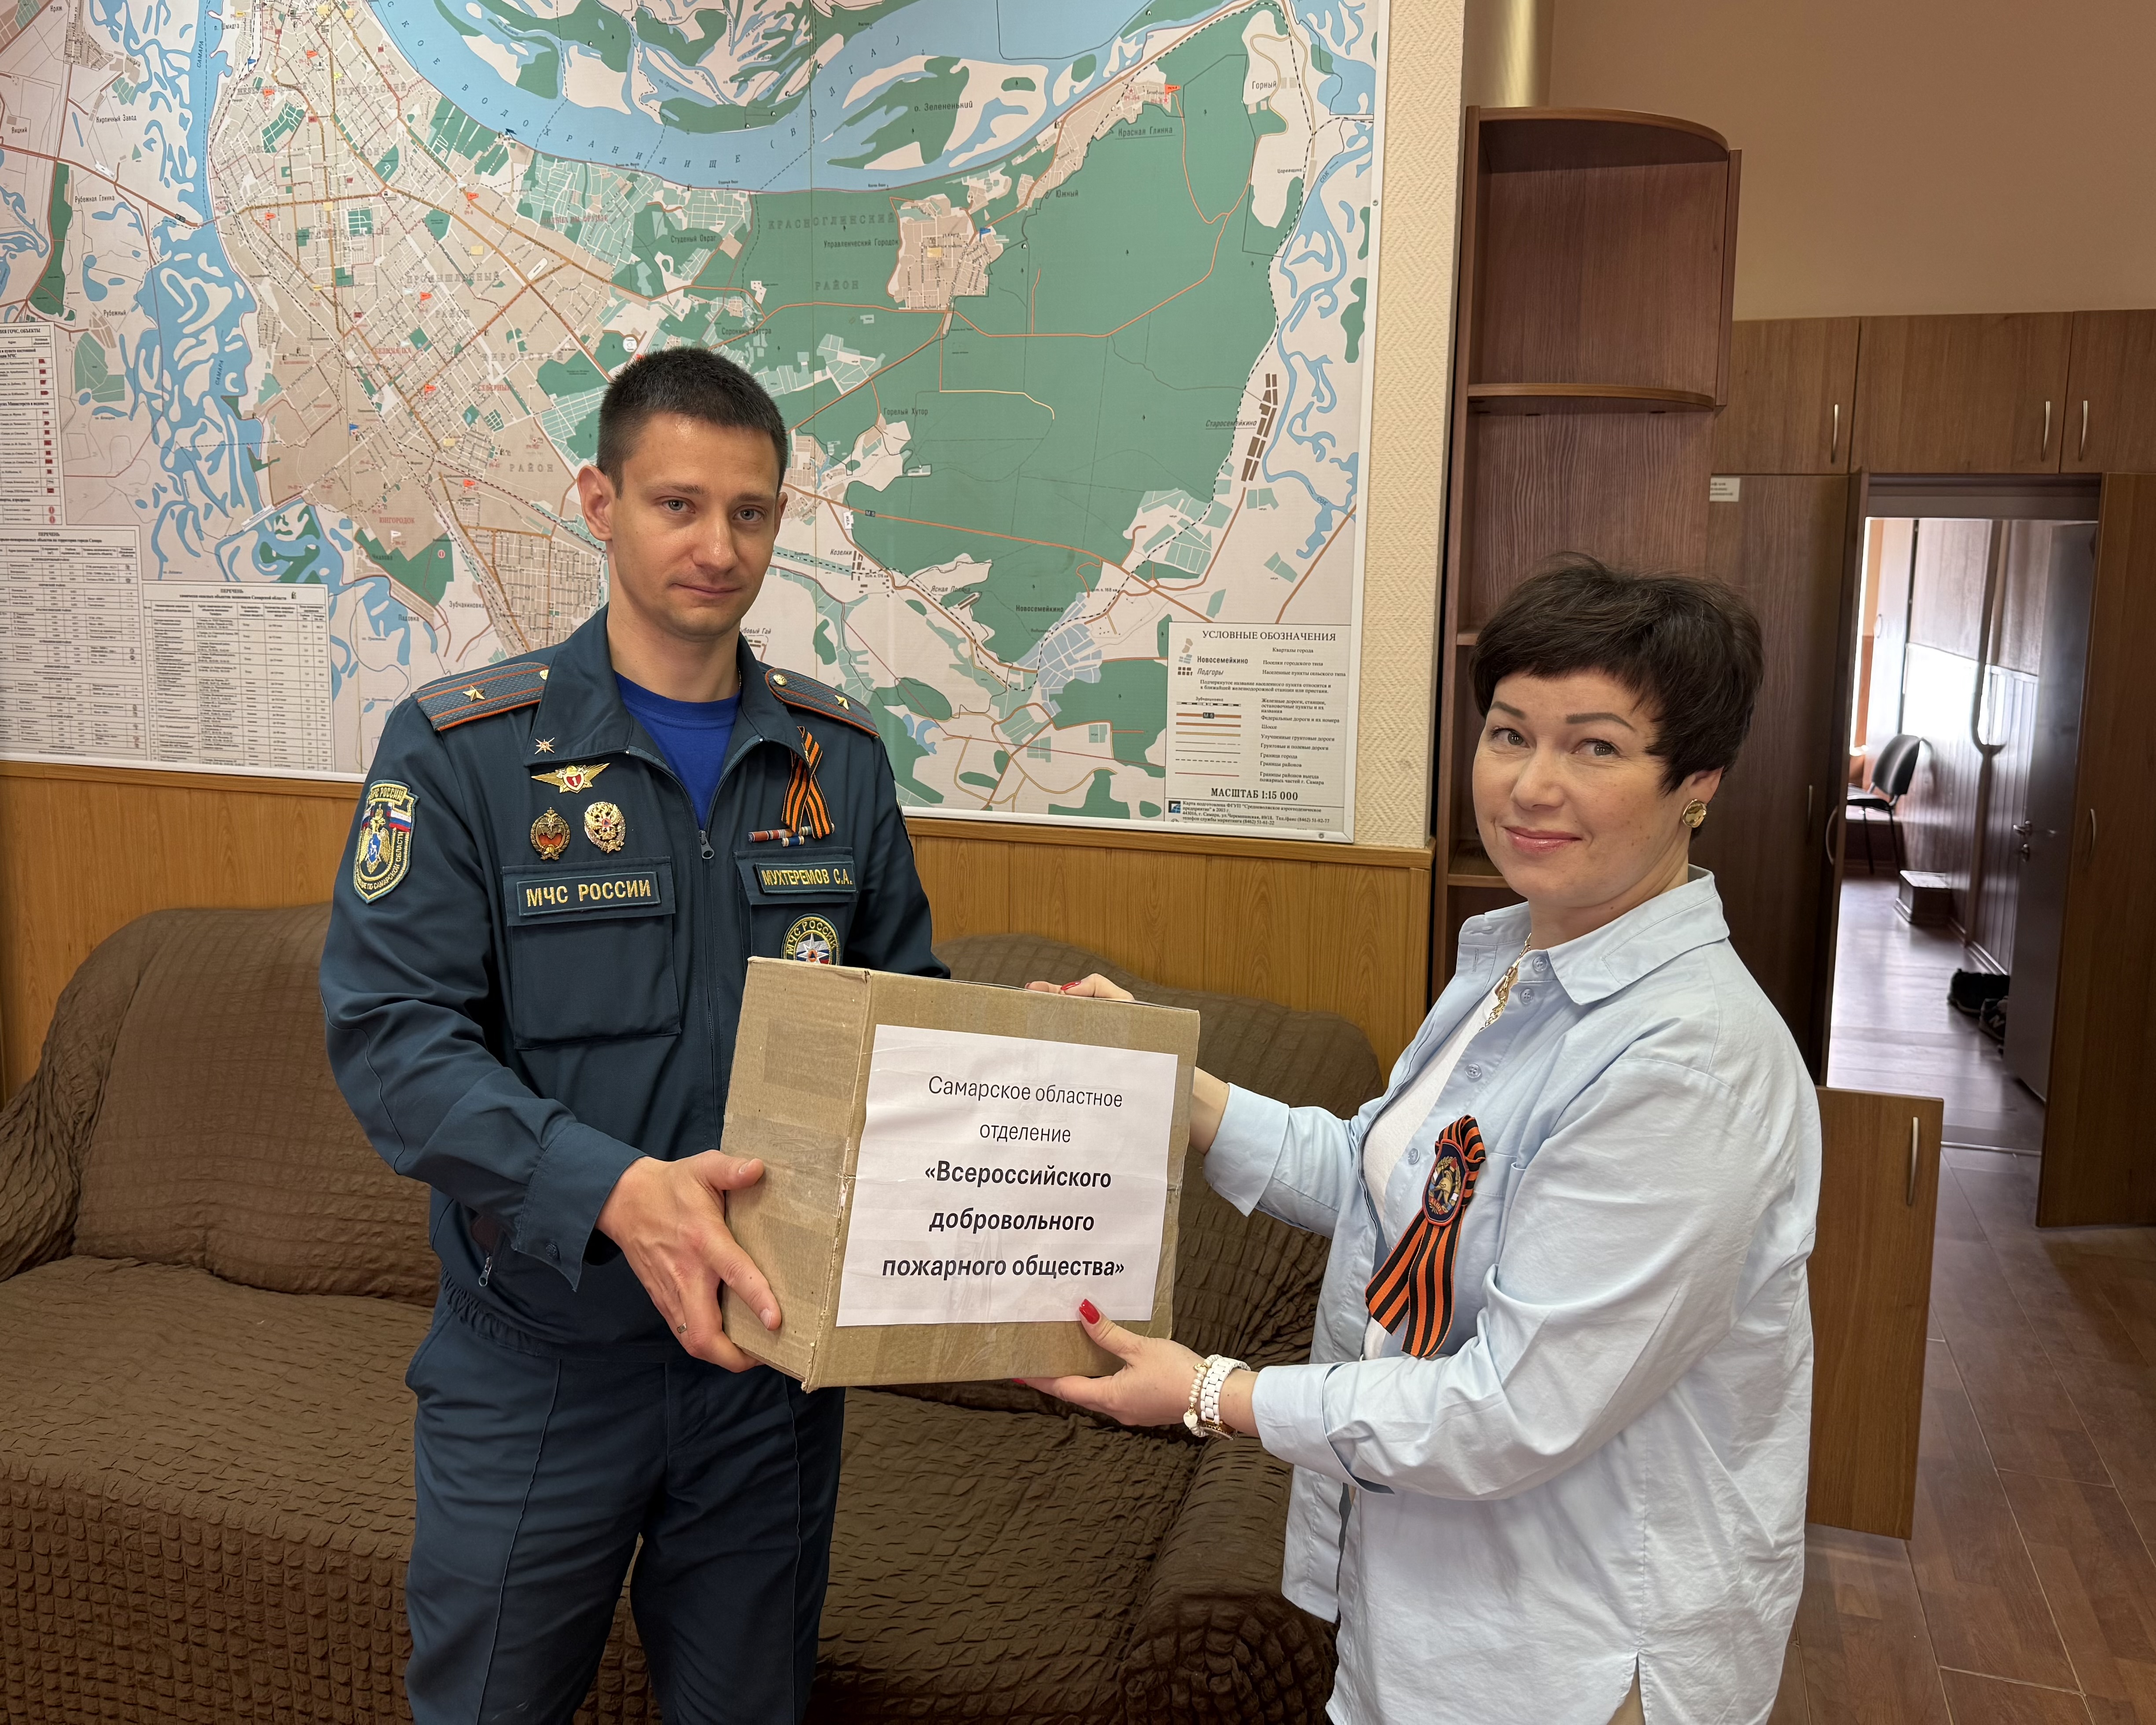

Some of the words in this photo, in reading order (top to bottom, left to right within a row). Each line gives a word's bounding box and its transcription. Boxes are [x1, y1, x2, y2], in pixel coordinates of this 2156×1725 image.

[1252, 81, 1277, 90] Горный
[924, 101, 973, 111] Зелененький
[1118, 128, 1146, 137] Красная
[1150, 126, 1172, 134] Глинка
[1319, 170, 1330, 183] СОК
[768, 212, 895, 230] КРАСНОГЛИНСКИЙ
[671, 235, 697, 243] Студеный
[823, 239, 871, 249] Управленческий
[874, 238, 899, 247] Городок
[815, 280, 859, 291] РАЙОН
[215, 360, 224, 385] САМАРА
[509, 462, 554, 472] РАЙОН
[1317, 496, 1328, 506] СОК
[1016, 604, 1064, 613] Новосемейкино
[1202, 631, 1258, 640] УСЛОВНЫЕ
[1260, 632, 1336, 641] ОБОЗНАЧЕНИЯ
[572, 776, 578, 786] 1
[380, 787, 404, 801] РОССИИ
[1211, 788, 1259, 799] МАСШТАБ
[1262, 791, 1277, 800] 1:15
[1280, 791, 1298, 801] 000
[396, 831, 404, 863] ОБЛАСТИ
[761, 868, 830, 886] МУХТЕРЕМОВ
[834, 868, 853, 885] С.А.
[526, 886, 569, 907] МЧС
[578, 879, 651, 902] РОССИИ
[786, 927, 801, 956] МЧС
[801, 920, 837, 951] РОССИИ
[928, 1075, 1031, 1101] Самарское
[1035, 1084, 1123, 1108] областное
[980, 1123, 1071, 1143] отделение
[925, 1160, 1112, 1188] «Всероссийского
[929, 1208, 1095, 1234] добровольного
[882, 1257, 1007, 1281] пожарного
[1012, 1254, 1125, 1278] общества»
